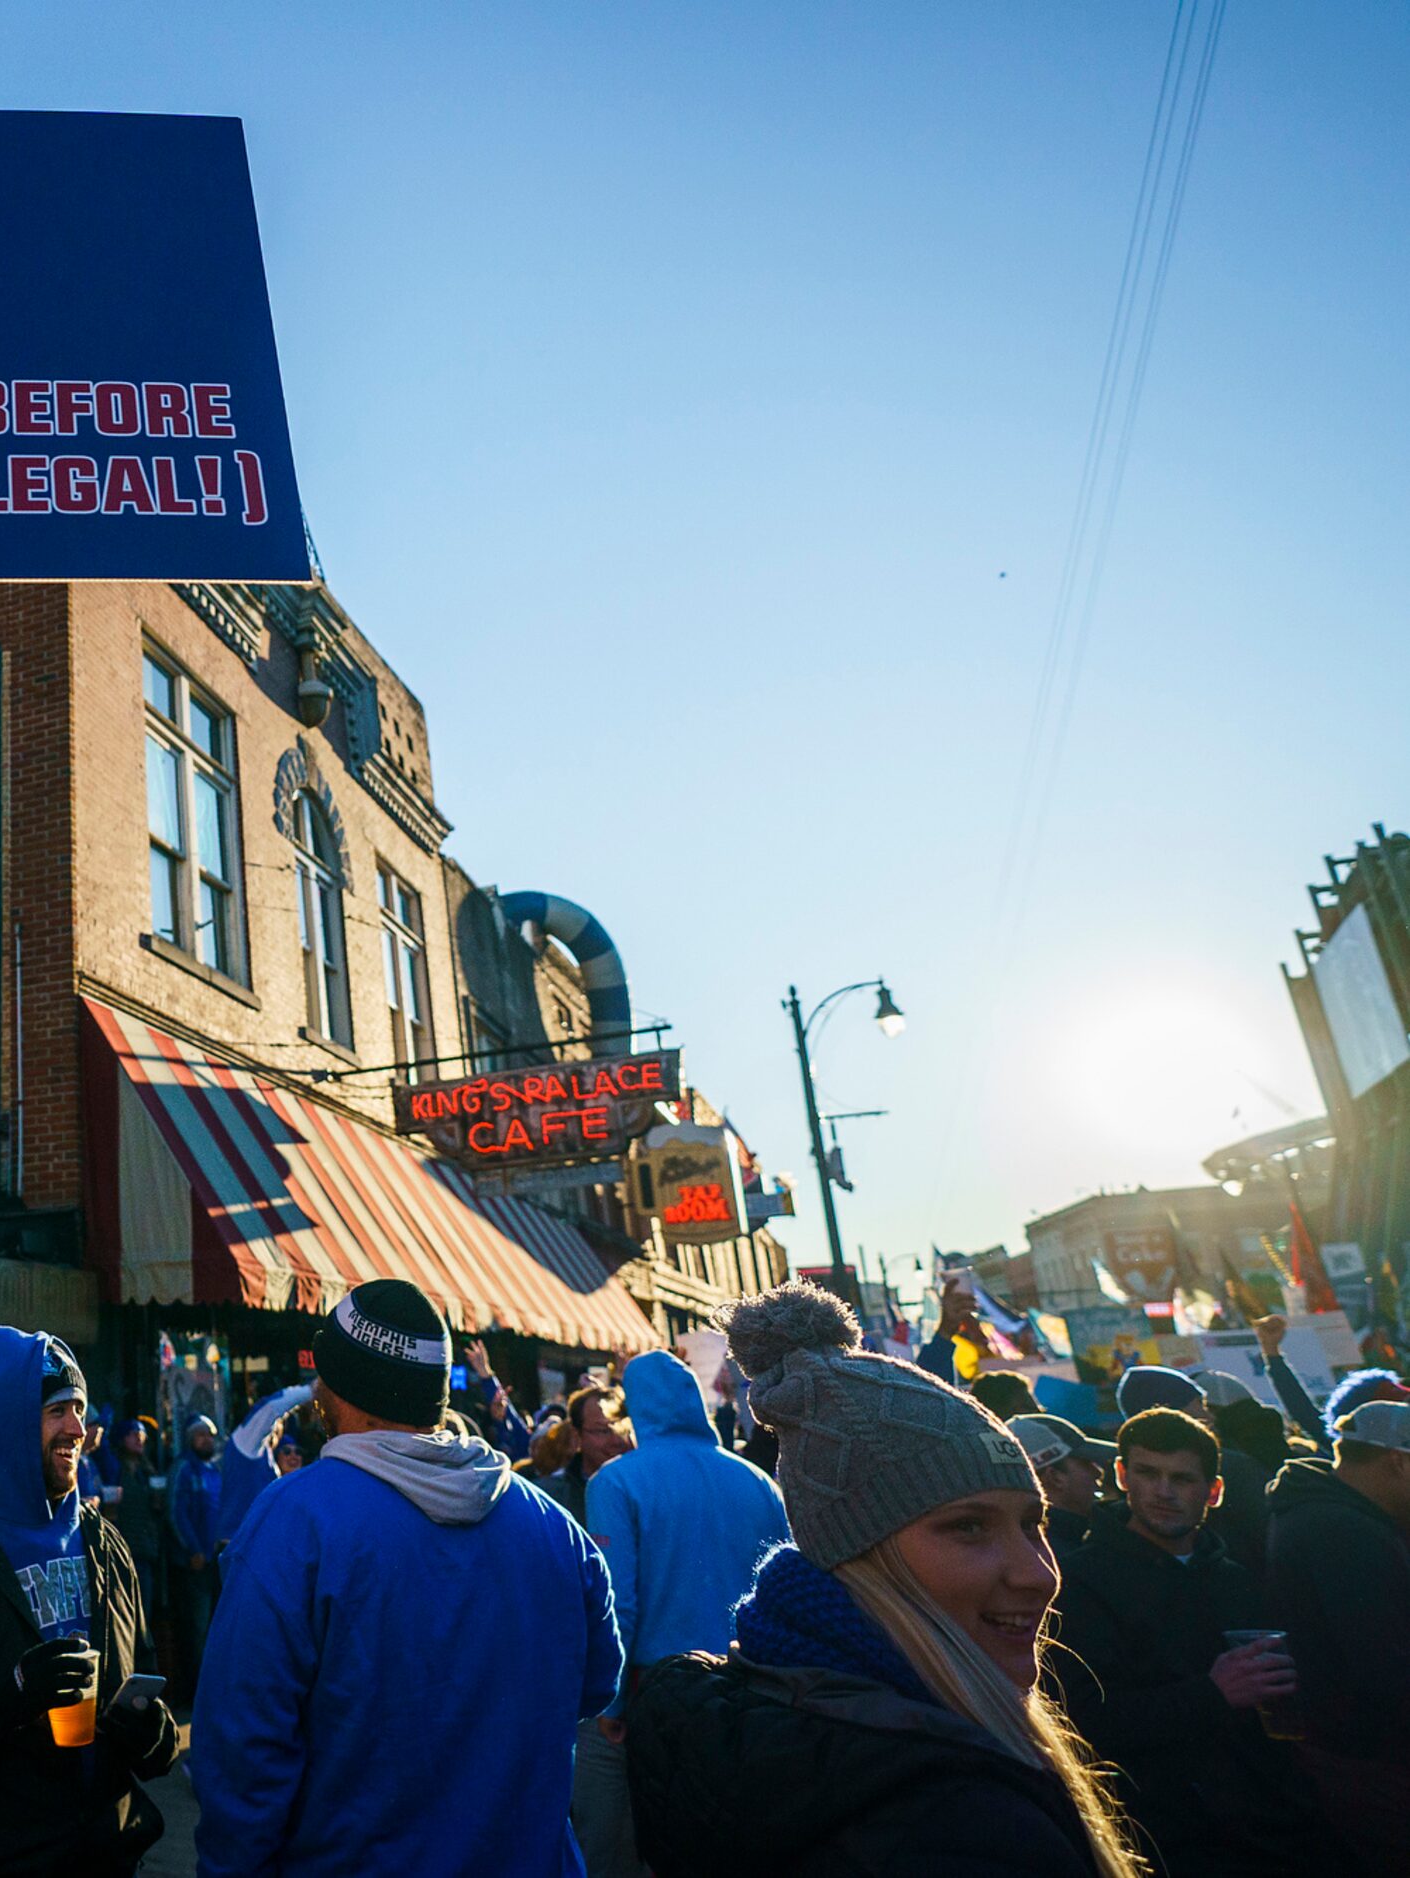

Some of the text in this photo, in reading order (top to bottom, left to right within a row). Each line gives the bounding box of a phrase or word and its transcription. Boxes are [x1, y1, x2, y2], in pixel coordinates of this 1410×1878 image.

[468, 1106, 609, 1153] CAFE
[663, 1199, 732, 1224] ROOM
[348, 1308, 418, 1350] MEMPHIS
[350, 1324, 404, 1358] TIGERS
